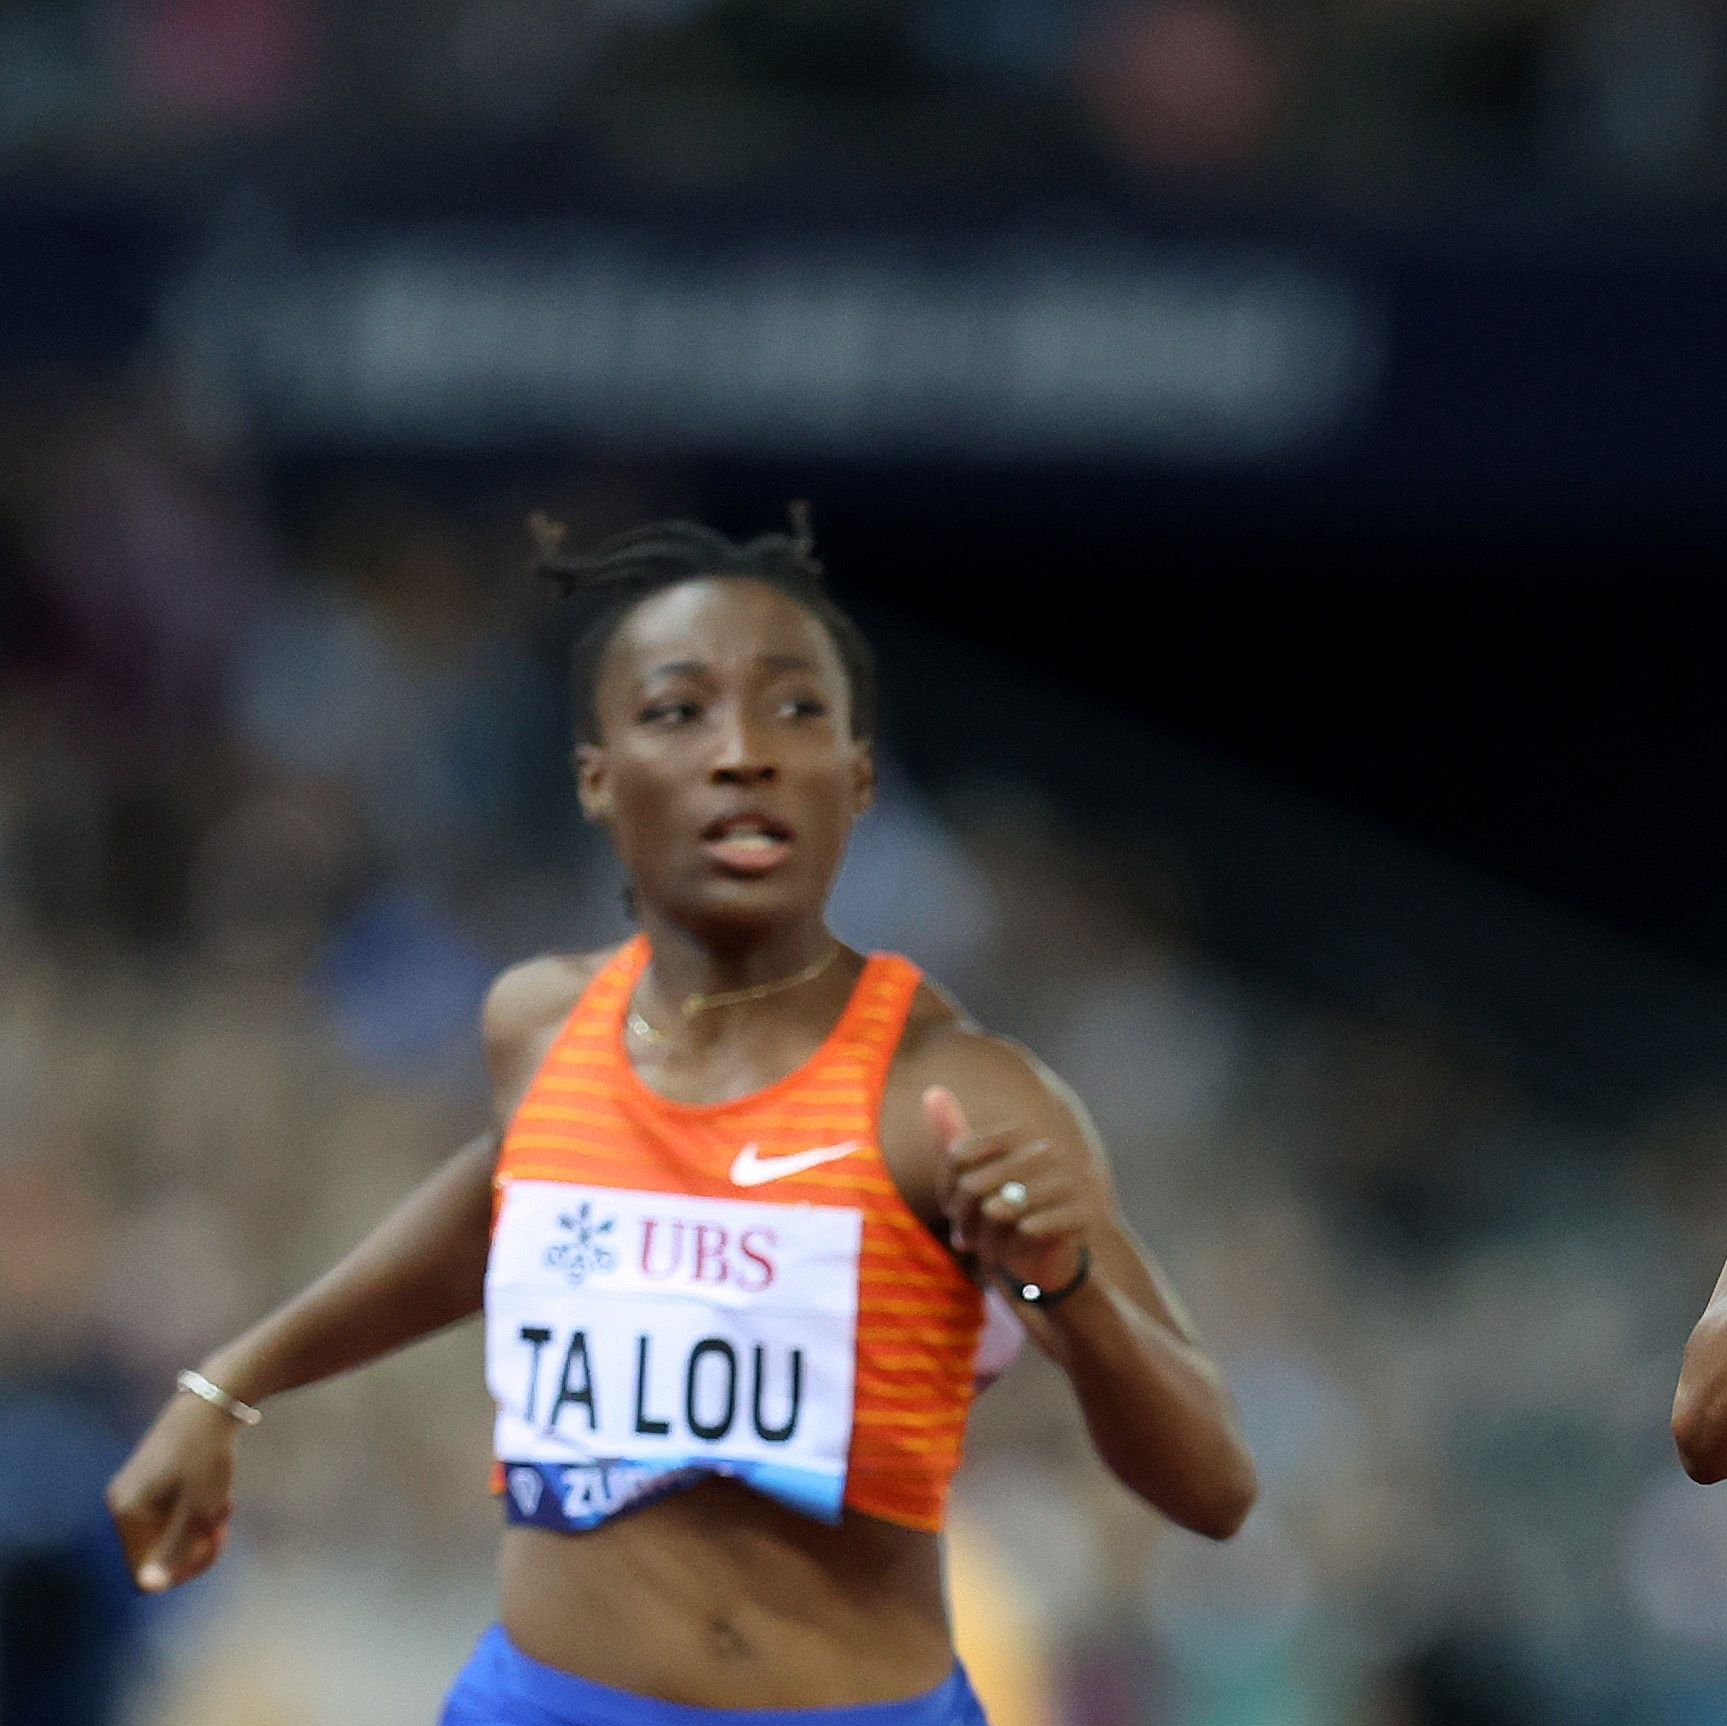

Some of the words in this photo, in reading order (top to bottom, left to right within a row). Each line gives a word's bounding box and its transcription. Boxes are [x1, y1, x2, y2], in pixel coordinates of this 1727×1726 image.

[637, 1217, 778, 1291] UBS
[520, 1327, 596, 1430] TA
[635, 1336, 802, 1442] LOU
